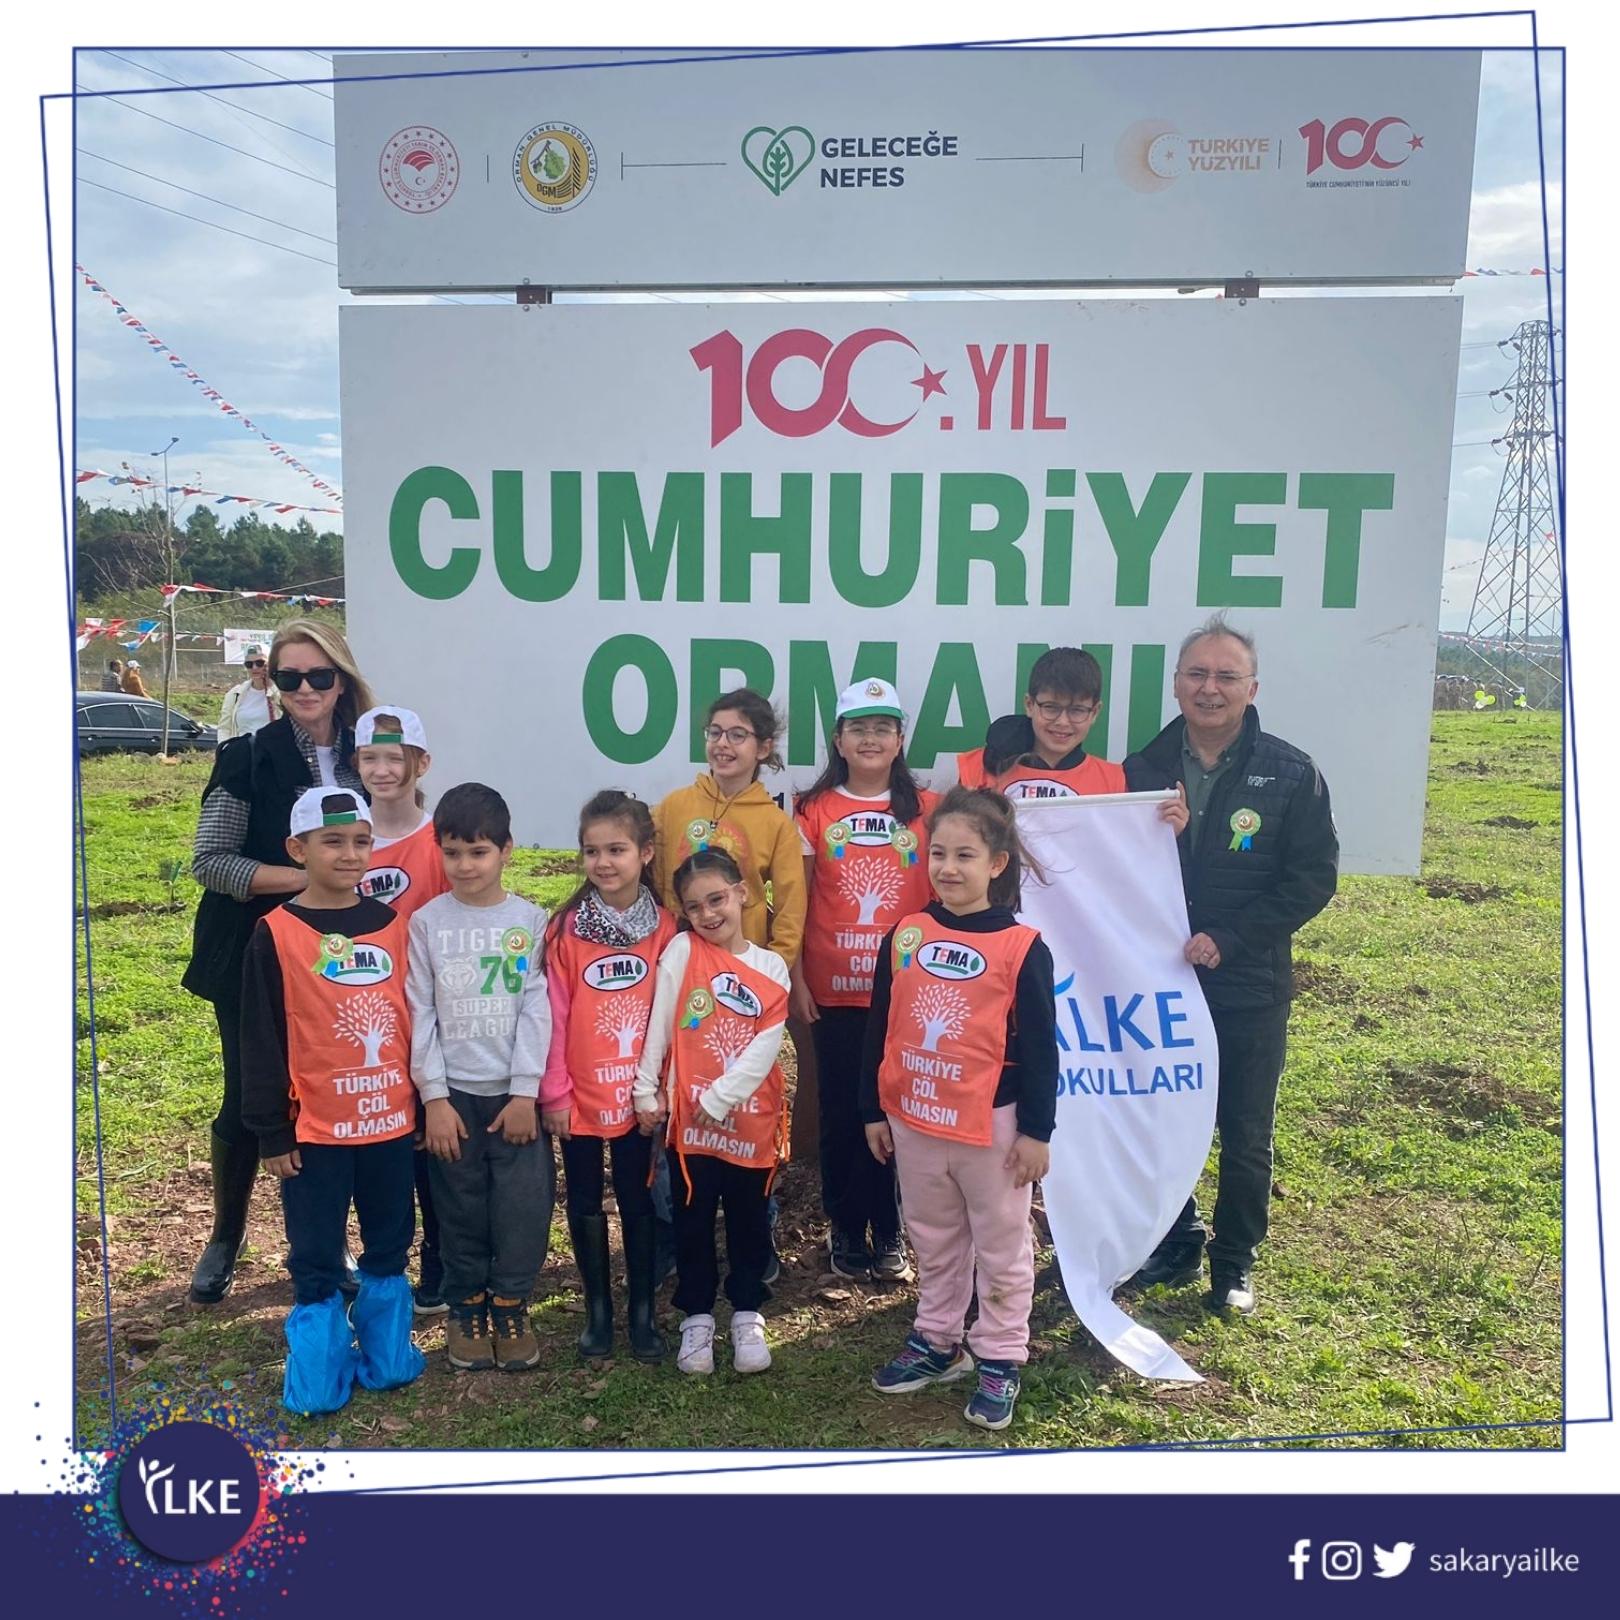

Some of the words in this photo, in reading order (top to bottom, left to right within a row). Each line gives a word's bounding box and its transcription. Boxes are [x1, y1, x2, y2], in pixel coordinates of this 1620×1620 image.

[821, 130, 958, 158] GELECEĞE
[820, 167, 904, 188] NEFES
[536, 184, 557, 198] OGM
[1020, 784, 1056, 798] TEMA
[851, 817, 887, 832] TEMA
[438, 927, 503, 954] TIGE
[835, 929, 884, 949] TÜRKİ
[339, 951, 377, 969] TEMA
[932, 946, 969, 968] TEMA
[480, 956, 522, 994] 76
[597, 960, 634, 979] TEMA
[832, 975, 874, 991] OLMA
[442, 1018, 512, 1040] LEAGU
[594, 1059, 640, 1084] TÜRKİ
[901, 1050, 962, 1082] TÜRKİYE
[332, 1067, 402, 1096] TÜRKİYE
[912, 1076, 939, 1101] ÇÖL
[357, 1092, 391, 1118] ÇÖL
[333, 1111, 408, 1140] OLMASIN
[683, 1127, 757, 1159] OLMASIN
